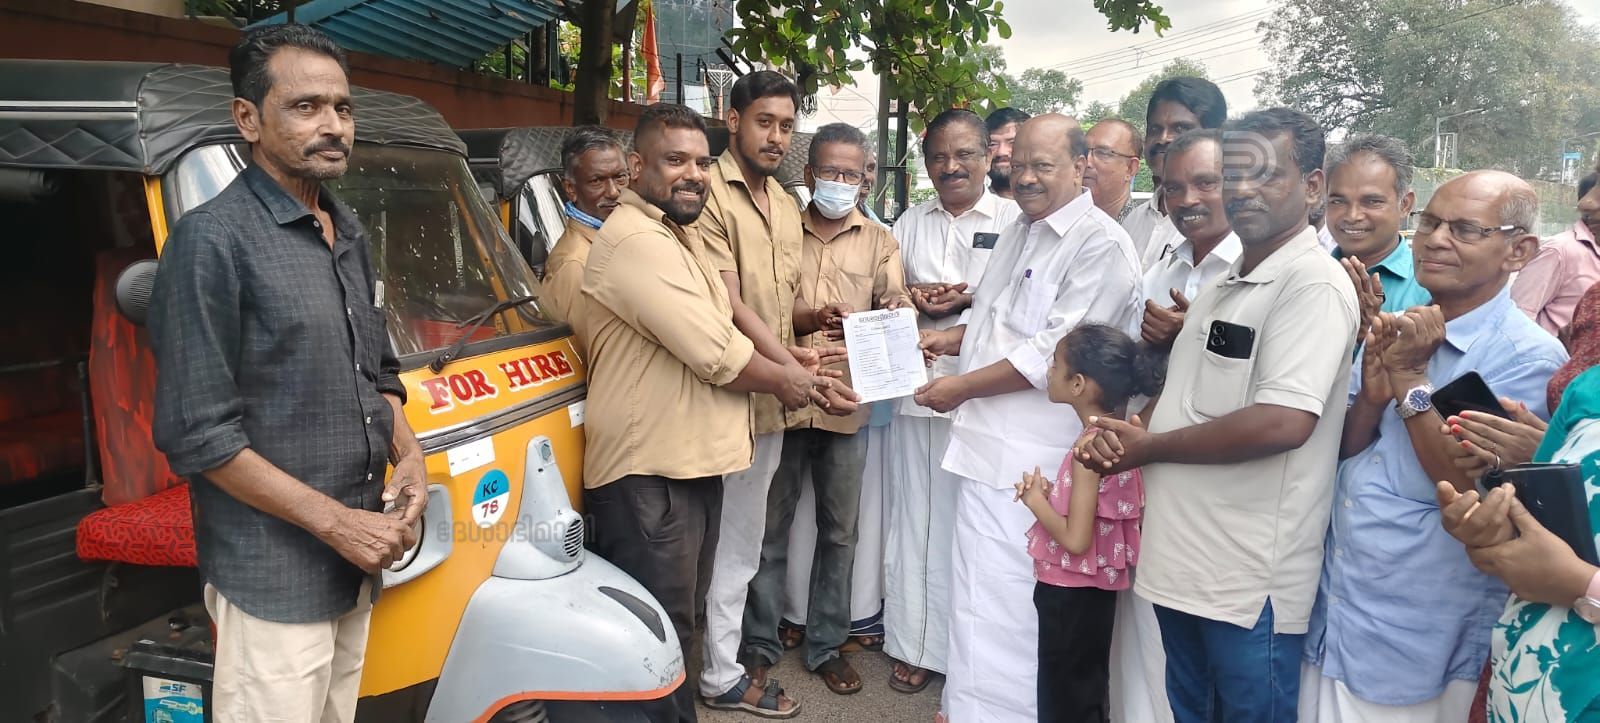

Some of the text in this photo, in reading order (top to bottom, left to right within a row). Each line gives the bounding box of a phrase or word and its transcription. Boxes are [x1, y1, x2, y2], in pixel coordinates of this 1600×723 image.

[420, 350, 574, 412] FOR HIRE
[481, 500, 499, 519] 78
[172, 684, 187, 692] SF
